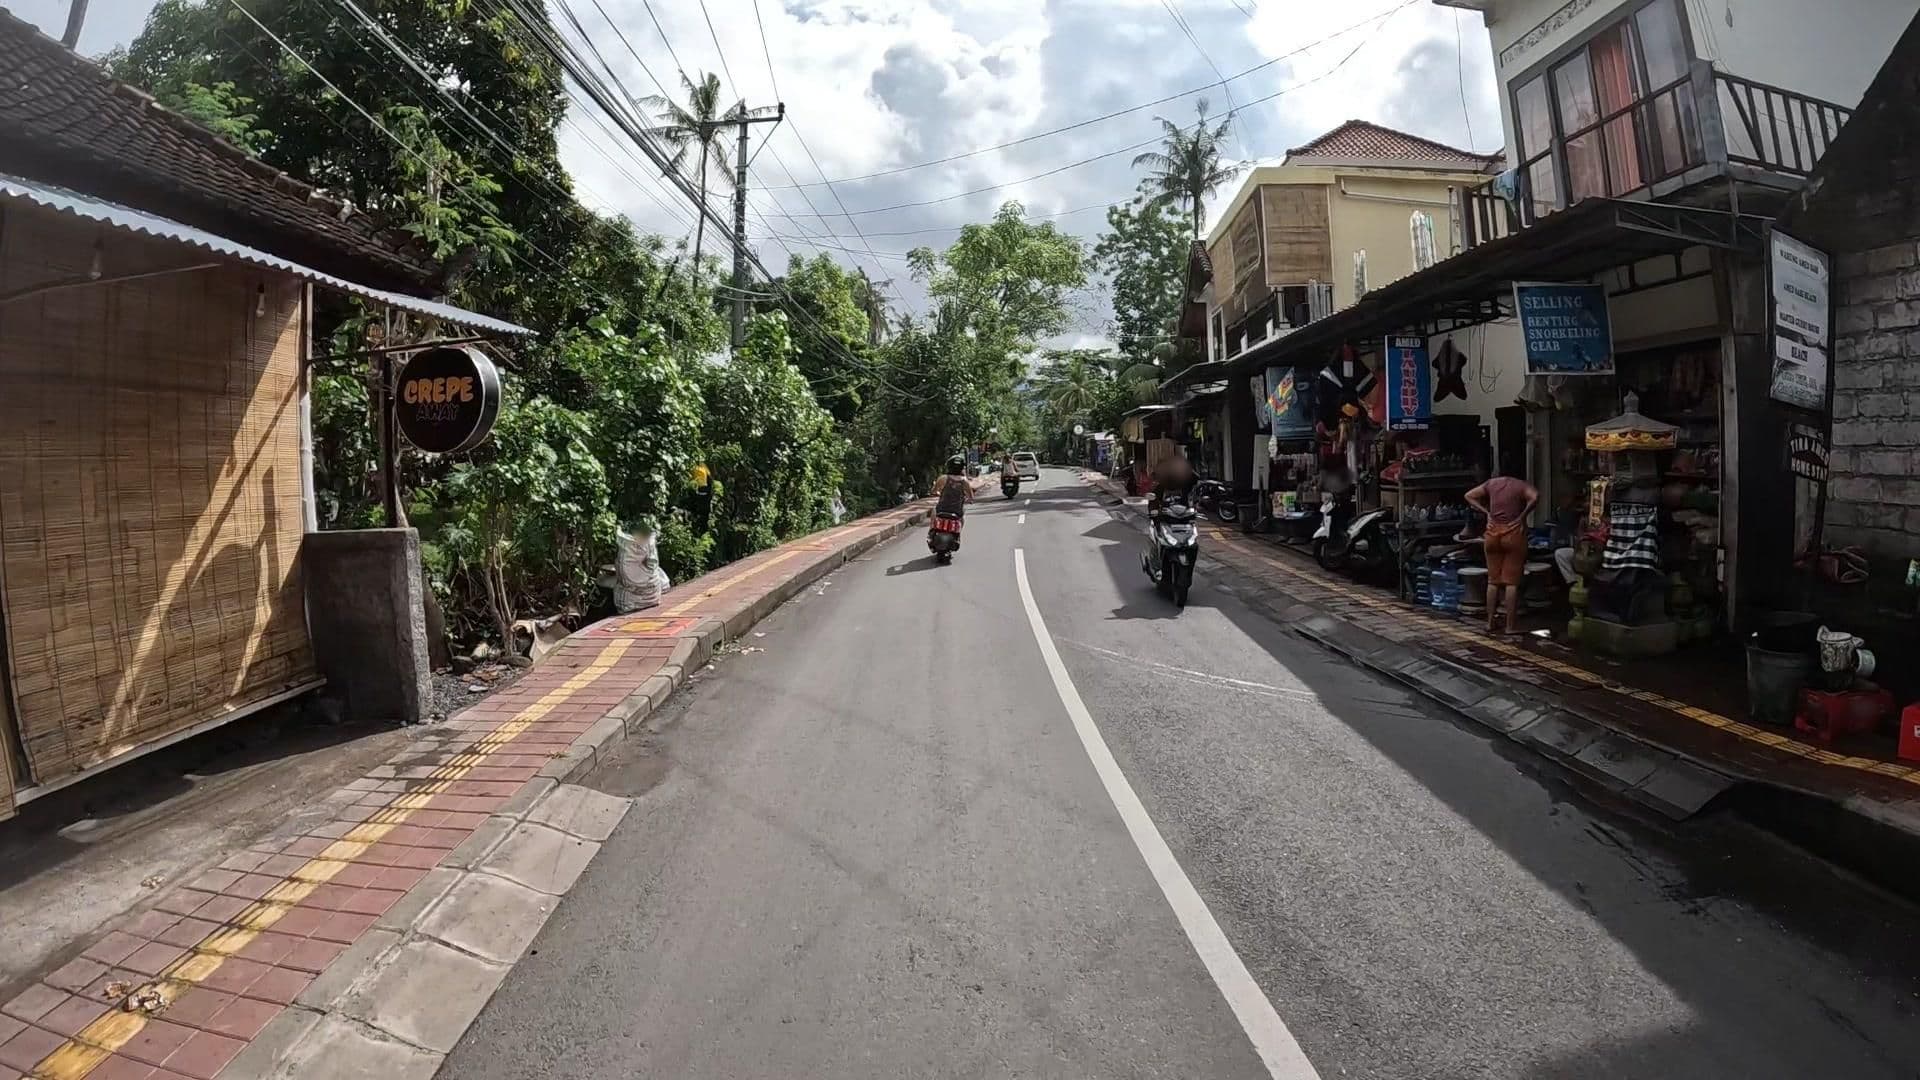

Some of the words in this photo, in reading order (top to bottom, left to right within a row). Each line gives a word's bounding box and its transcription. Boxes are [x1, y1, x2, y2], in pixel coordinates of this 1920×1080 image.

[1523, 295, 1583, 309] SELLING
[1527, 315, 1578, 327] RENTING
[1529, 327, 1601, 339] SNORKELING
[1530, 341, 1560, 352] GEAR
[404, 376, 474, 404] CREPE
[416, 402, 460, 421] AWAY
